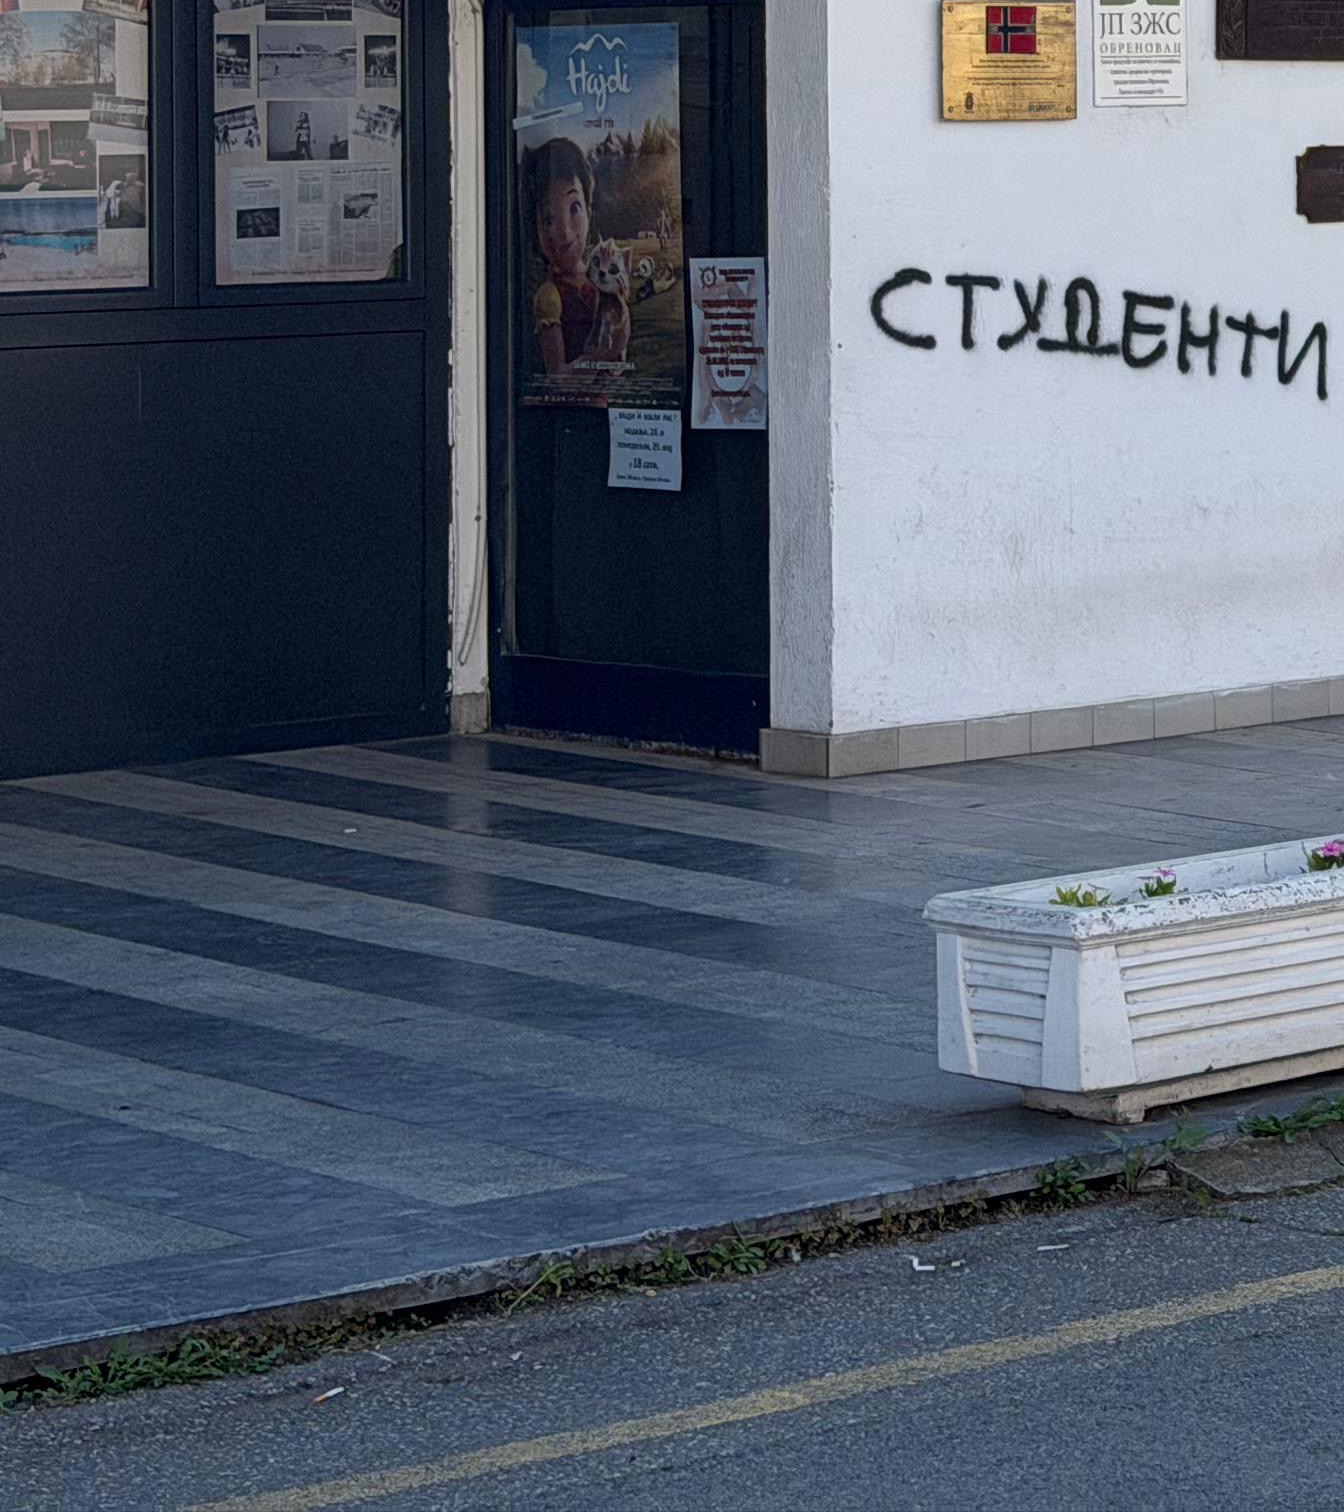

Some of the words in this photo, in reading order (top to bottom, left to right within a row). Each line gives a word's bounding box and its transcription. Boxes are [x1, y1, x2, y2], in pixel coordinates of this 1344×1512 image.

[1130, 11, 1182, 36] ЗЖС
[1099, 41, 1182, 55] ОБРЕНОВАЦ
[566, 56, 632, 114] Hajdi
[869, 267, 1330, 403] СТУДЕНТИ
